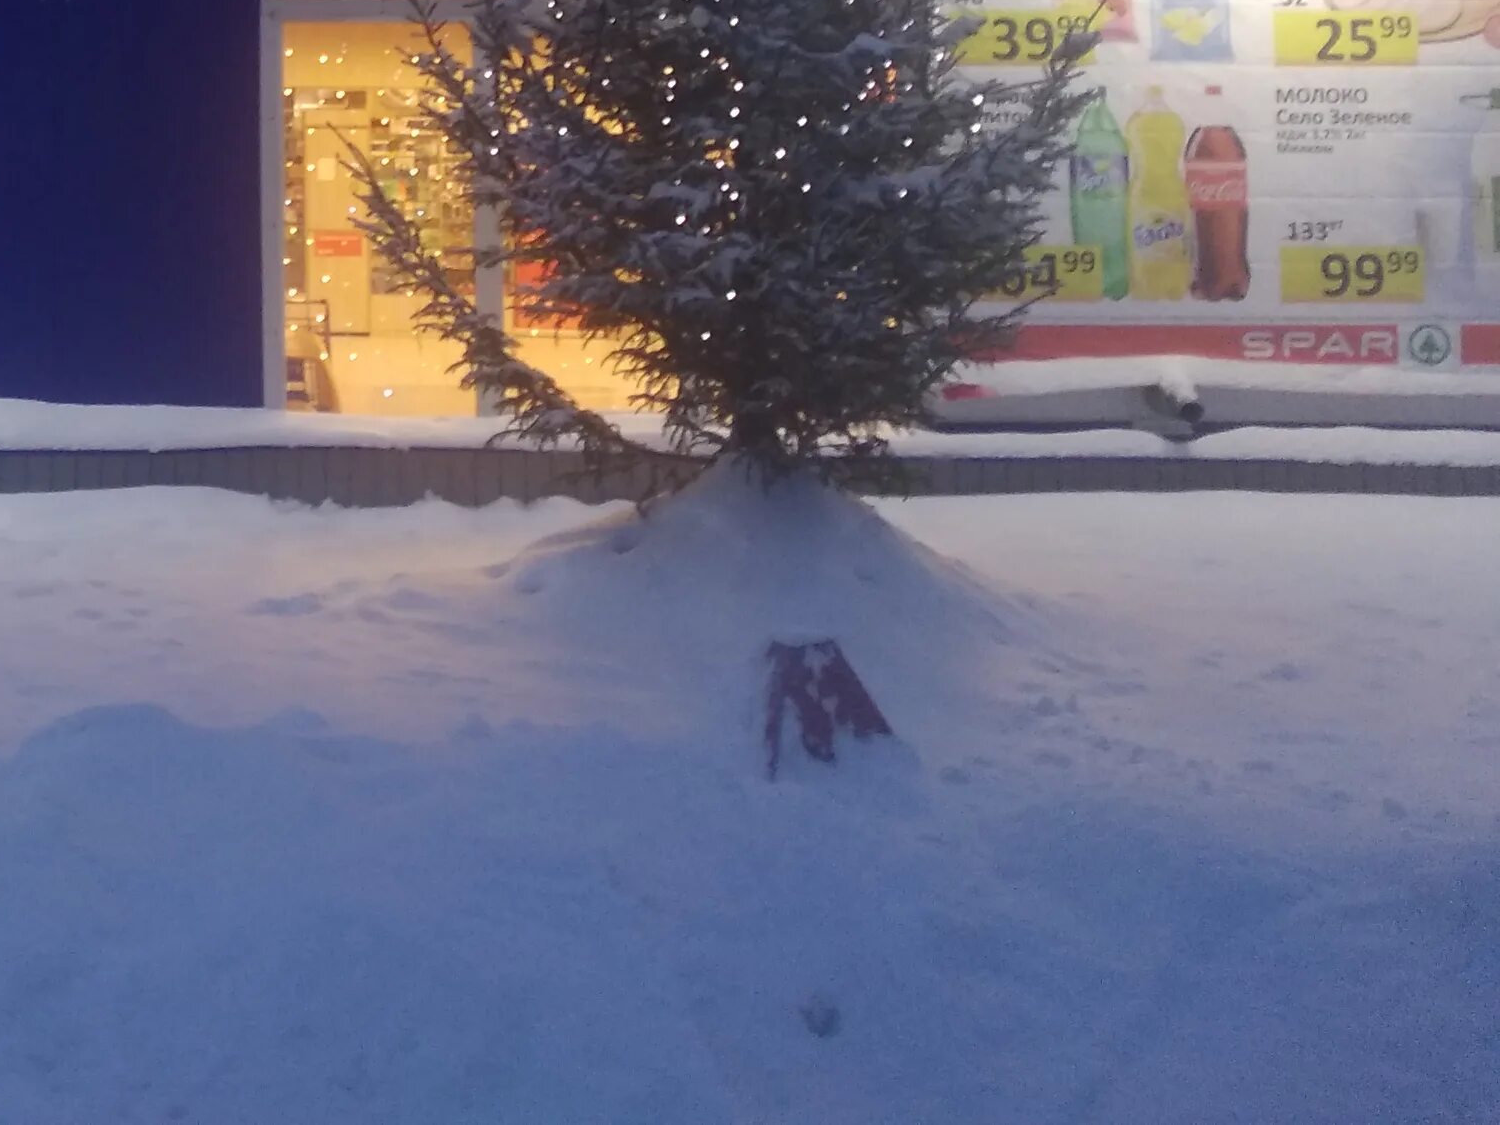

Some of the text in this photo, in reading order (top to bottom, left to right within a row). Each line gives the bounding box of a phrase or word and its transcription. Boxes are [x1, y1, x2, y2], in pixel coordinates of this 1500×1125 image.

[1276, 88, 1369, 104] МОЛОКО
[1276, 108, 1413, 125] Село Зеленое
[1242, 331, 1394, 359] SPAR
